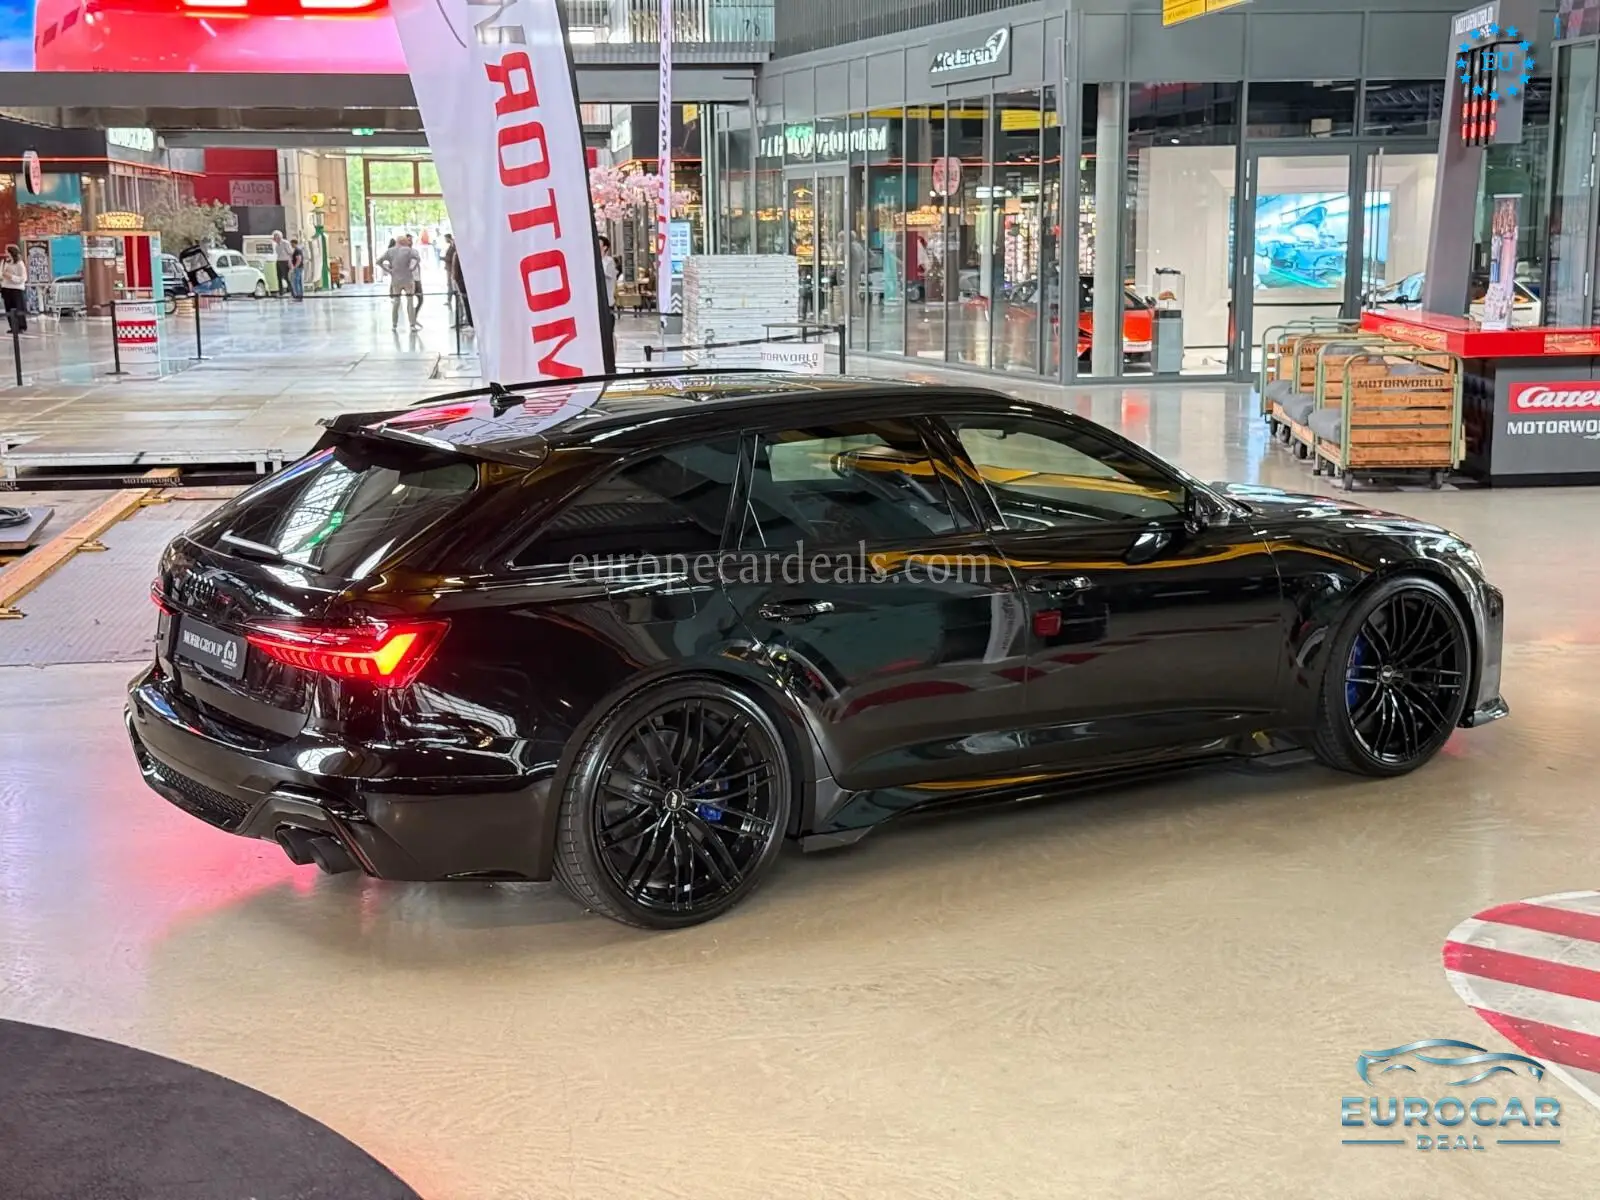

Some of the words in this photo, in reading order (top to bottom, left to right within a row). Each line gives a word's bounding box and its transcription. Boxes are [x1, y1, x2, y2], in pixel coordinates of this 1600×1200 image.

[930, 48, 997, 73] McLaren
[232, 182, 274, 195] Autos
[1357, 379, 1444, 389] MOTORWORLD
[1507, 420, 1600, 435] MOTORWO
